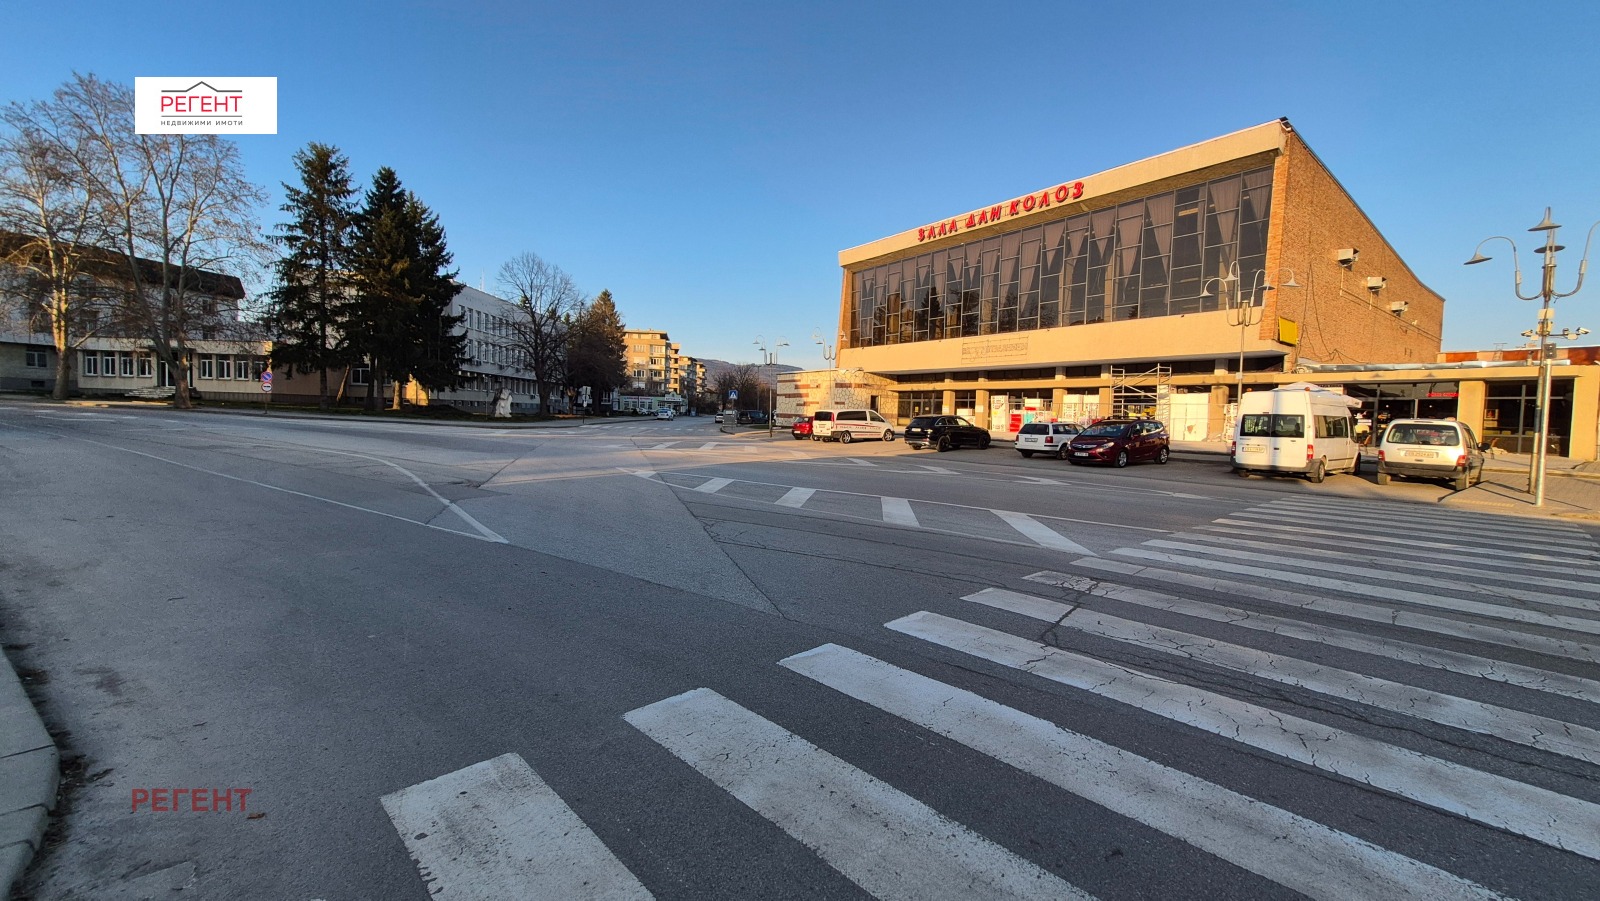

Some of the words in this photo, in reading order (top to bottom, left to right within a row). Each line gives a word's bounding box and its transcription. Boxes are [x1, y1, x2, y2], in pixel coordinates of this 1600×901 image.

[917, 218, 958, 242] ЗАЛА
[965, 205, 1003, 229] ДАН
[1009, 181, 1085, 216] КОЛОЗ
